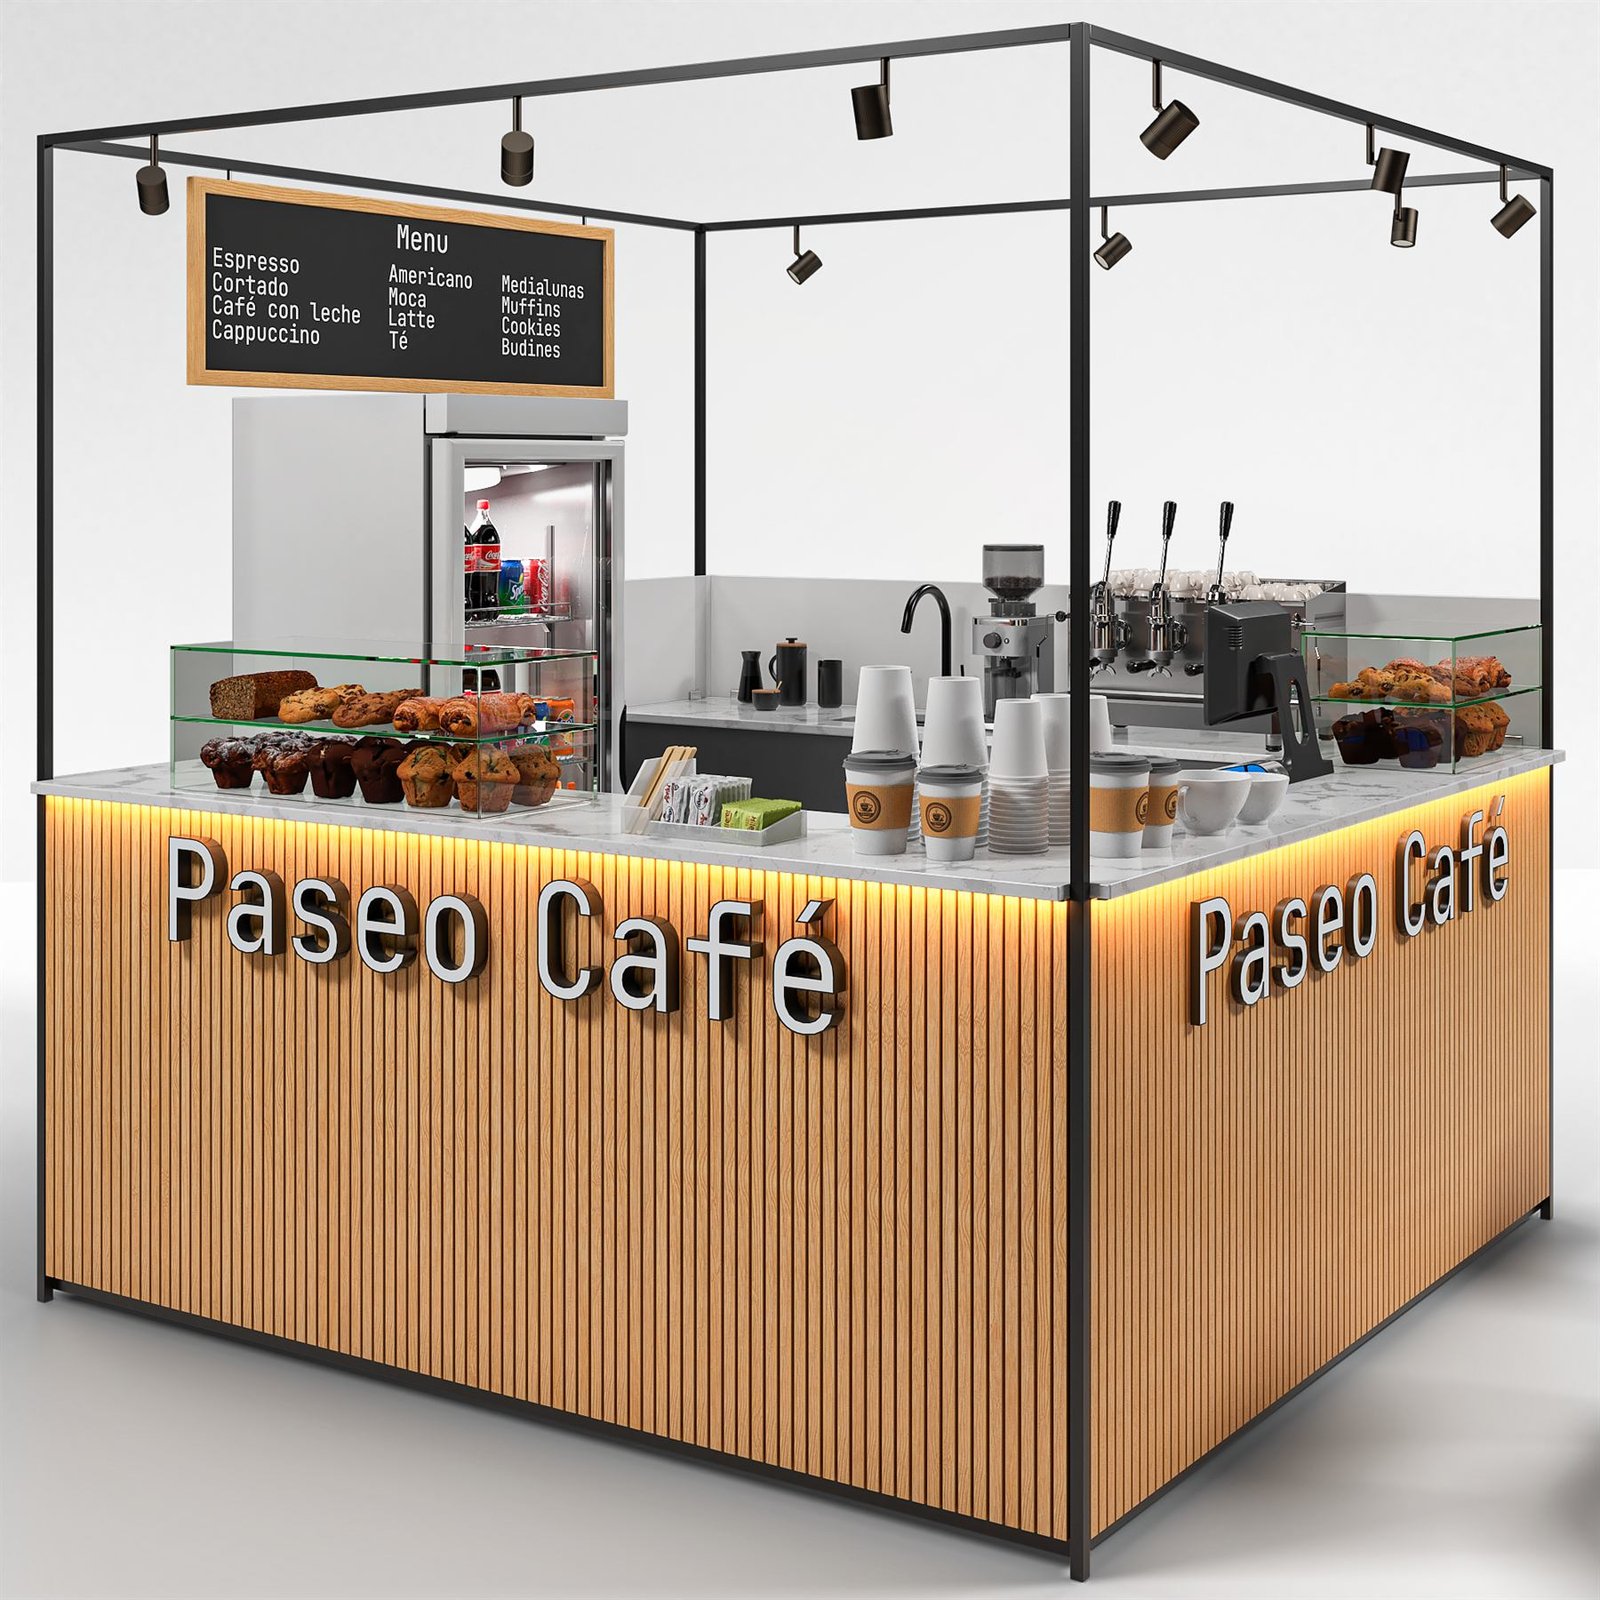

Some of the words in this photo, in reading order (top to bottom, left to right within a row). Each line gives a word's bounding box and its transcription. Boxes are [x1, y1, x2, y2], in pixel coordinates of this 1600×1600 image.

[396, 223, 448, 254] Menu
[212, 247, 300, 275] Espresso
[212, 272, 289, 298] Cortado
[388, 264, 473, 290] Americano
[501, 275, 585, 300] Medialunas
[212, 295, 256, 319] Café
[267, 303, 300, 321] con
[309, 302, 361, 325] leche
[388, 287, 427, 309] Moca
[501, 296, 561, 318] Muffins
[388, 308, 436, 329] Latte
[501, 316, 561, 338] Cookies
[212, 319, 320, 346] Cappuccino
[388, 330, 408, 351] Té
[501, 338, 561, 359] Budines
[1192, 872, 1377, 1026] Paseo
[1397, 795, 1509, 936] Café
[168, 836, 484, 984] Paseo
[537, 879, 844, 1036] Café
